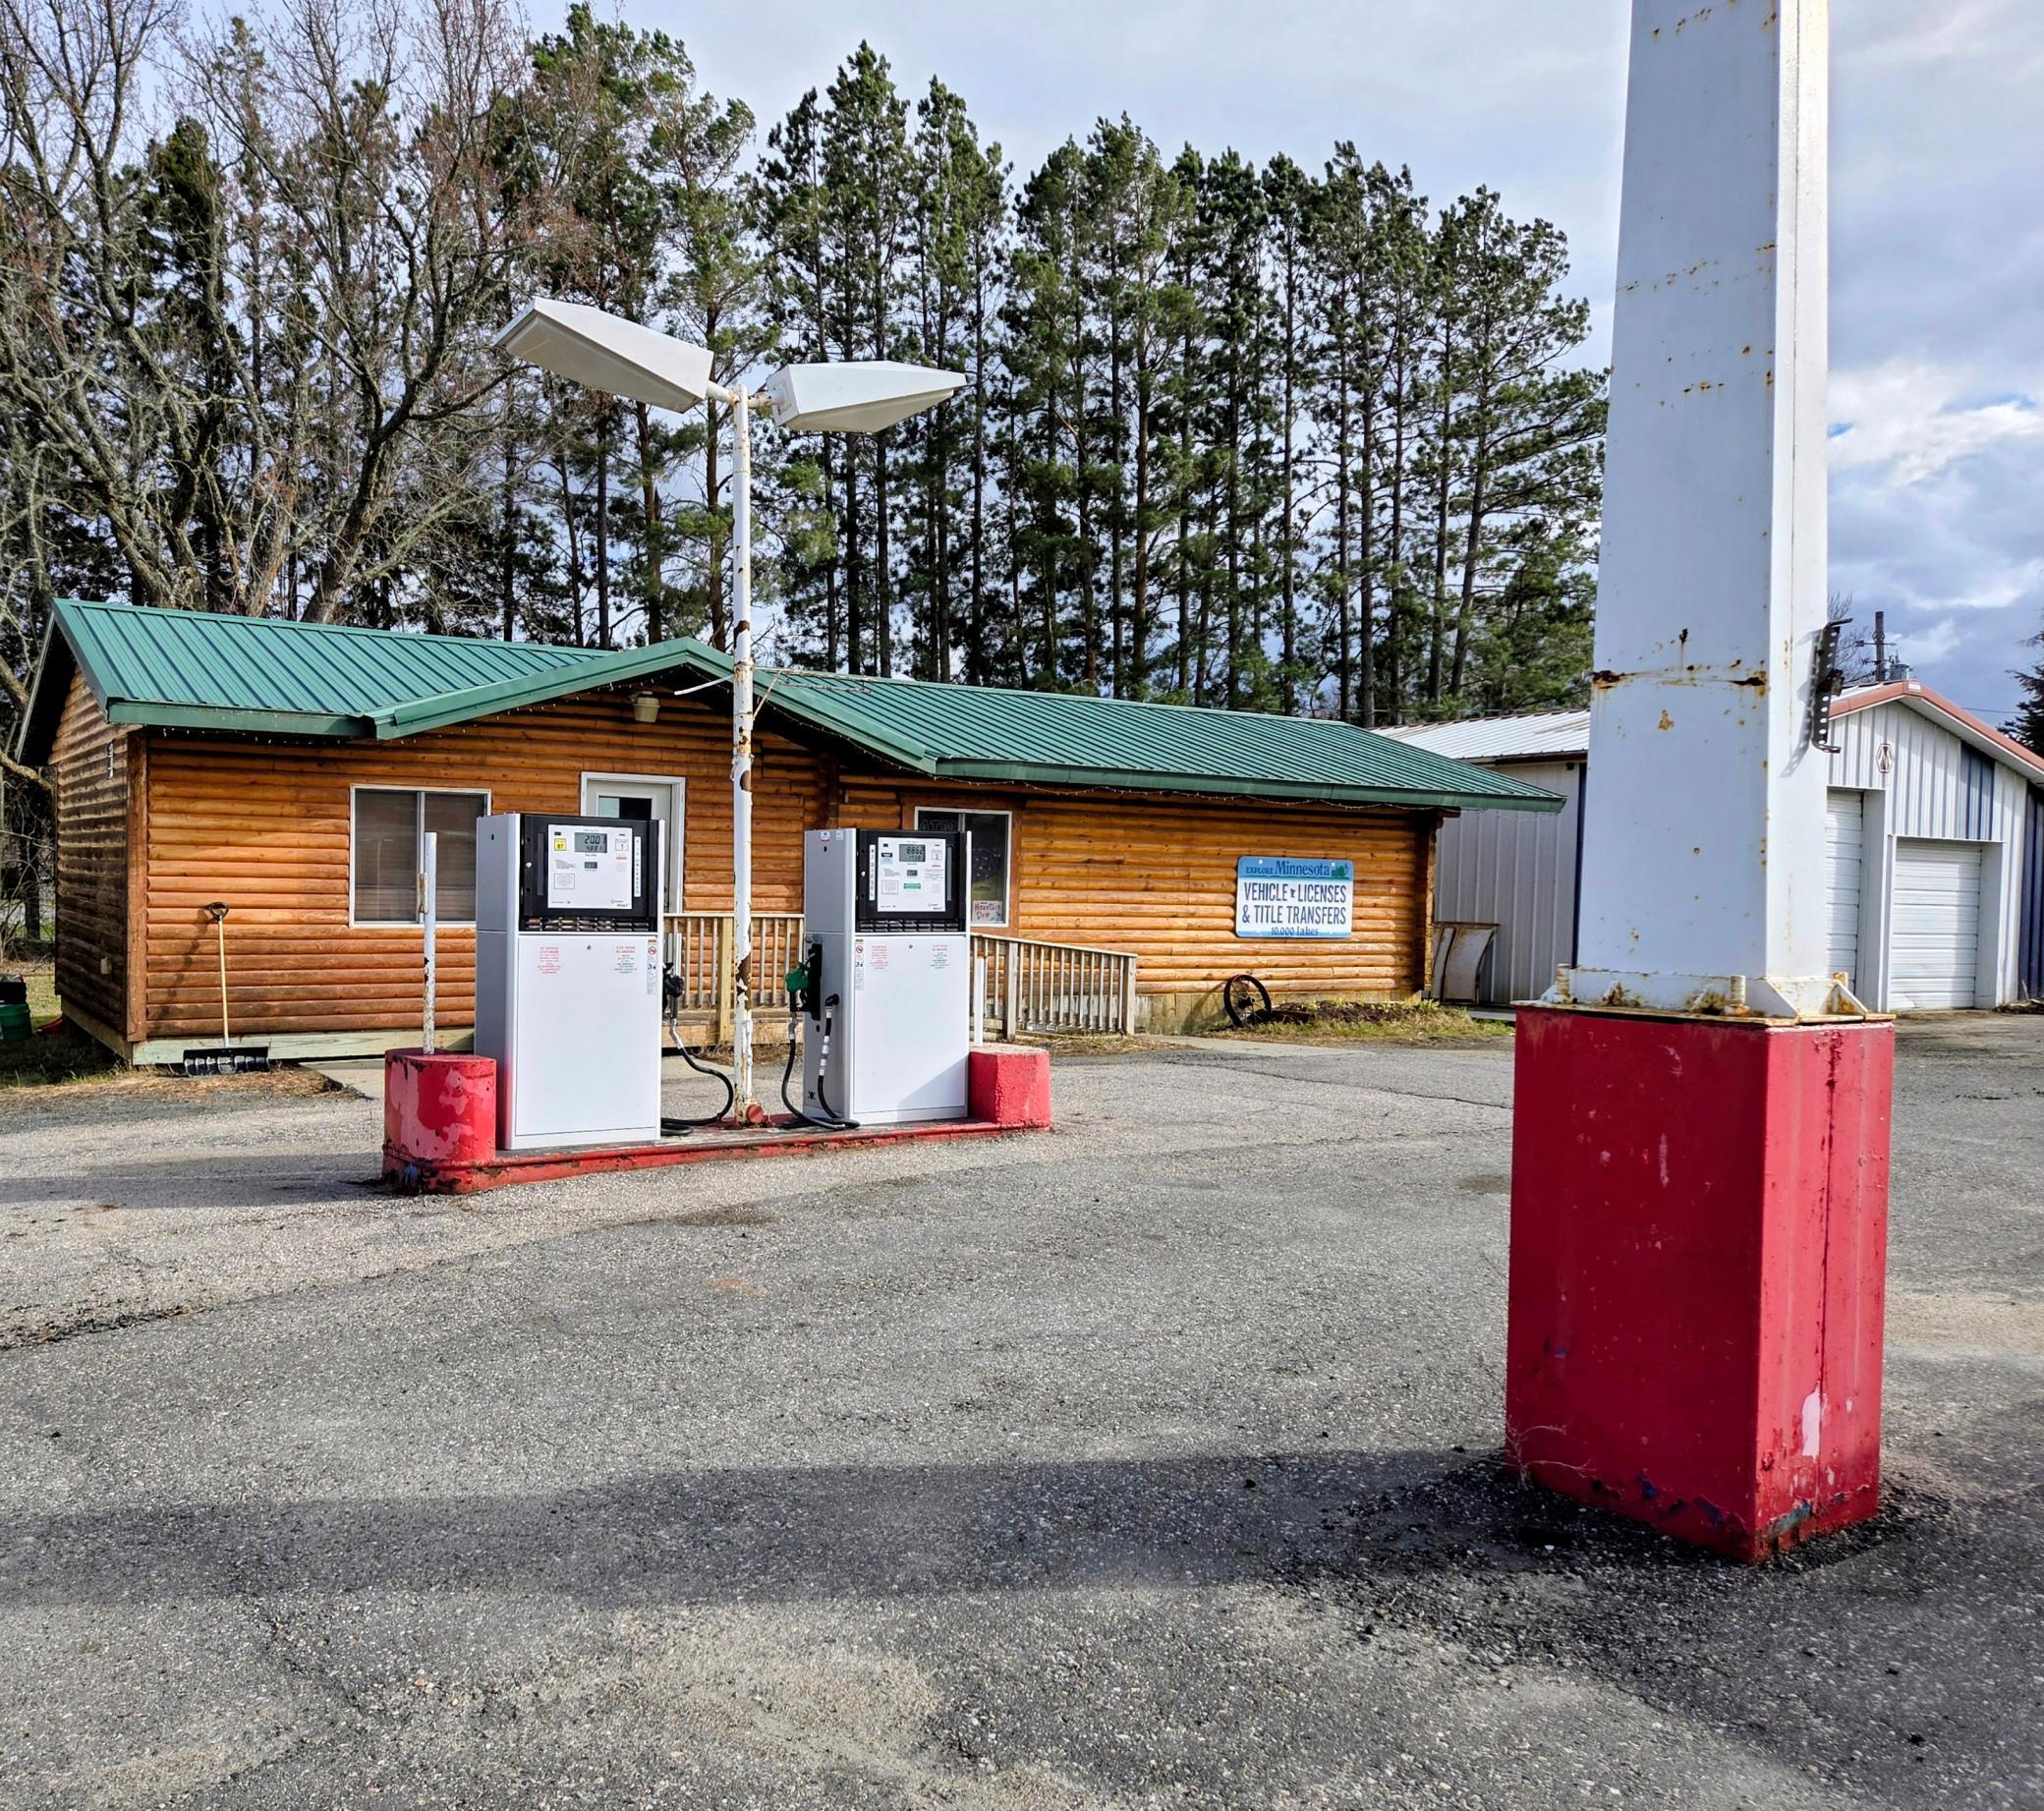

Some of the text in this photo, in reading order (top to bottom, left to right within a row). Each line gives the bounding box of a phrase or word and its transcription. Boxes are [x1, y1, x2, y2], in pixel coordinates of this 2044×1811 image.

[1245, 860, 1331, 877] EXPLORE Minnesota
[1244, 881, 1347, 903] VEHICLE LICENSES
[1241, 904, 1347, 925] & TITLE TRANSFERS
[1296, 926, 1319, 936] lakes
